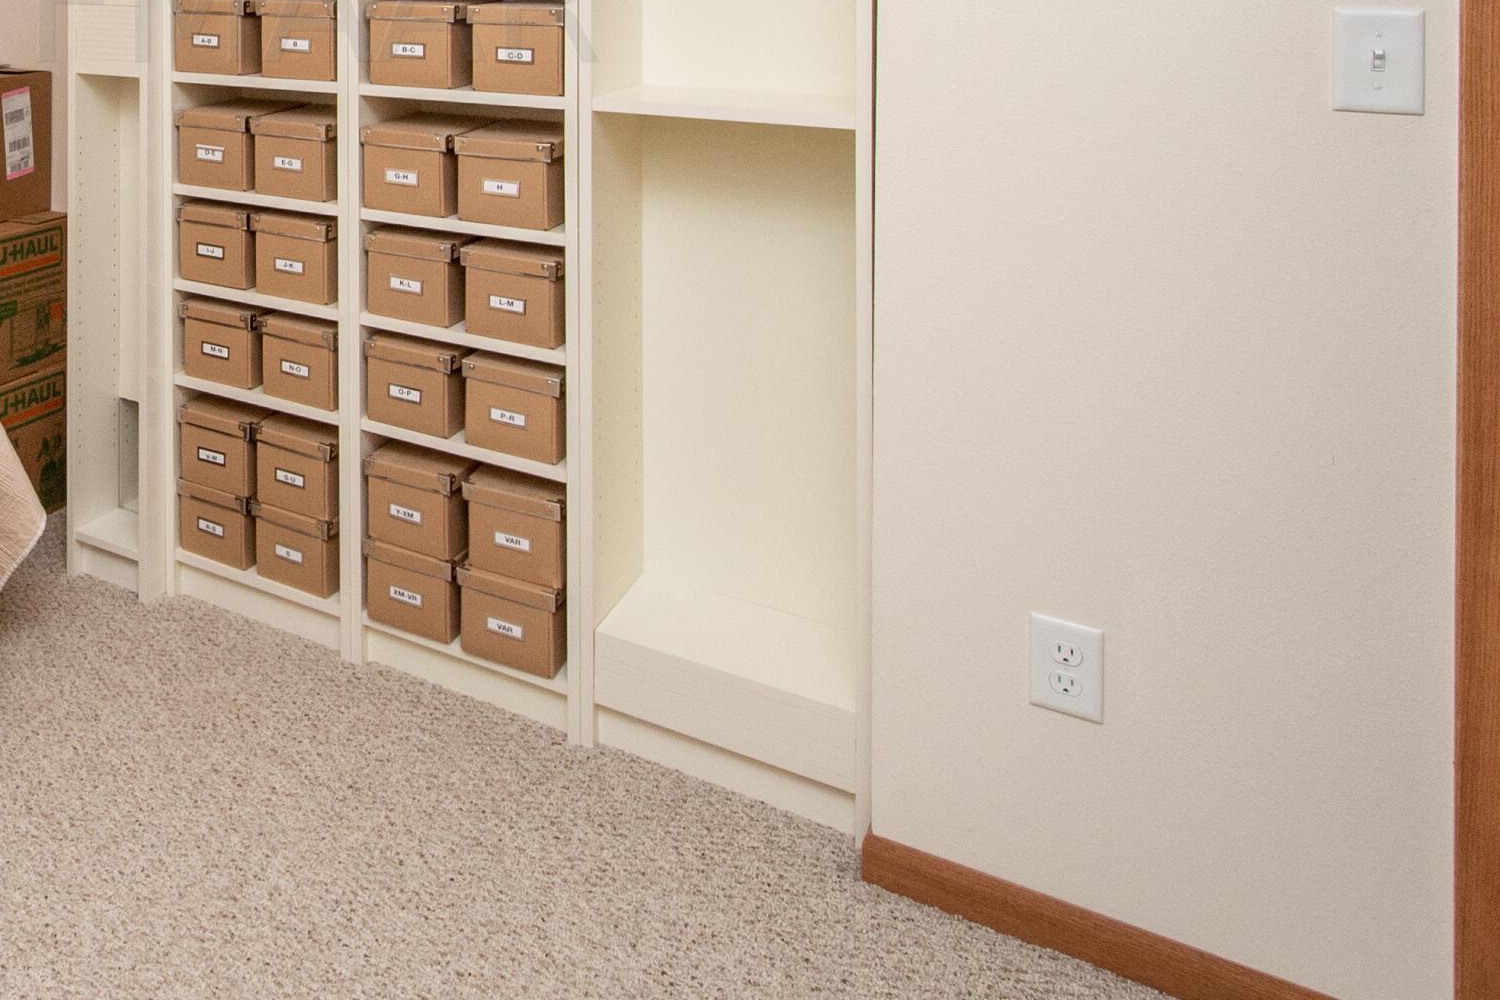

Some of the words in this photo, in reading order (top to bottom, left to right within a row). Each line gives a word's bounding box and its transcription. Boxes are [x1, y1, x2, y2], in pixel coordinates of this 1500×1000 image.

[402, 46, 416, 54] B-C
[507, 52, 523, 60] C-D
[394, 172, 409, 181] G-H
[399, 280, 412, 289] K-L
[498, 299, 514, 308] L-M
[500, 412, 515, 422] P-R
[504, 535, 521, 547] VAR
[496, 623, 514, 634] VAR
